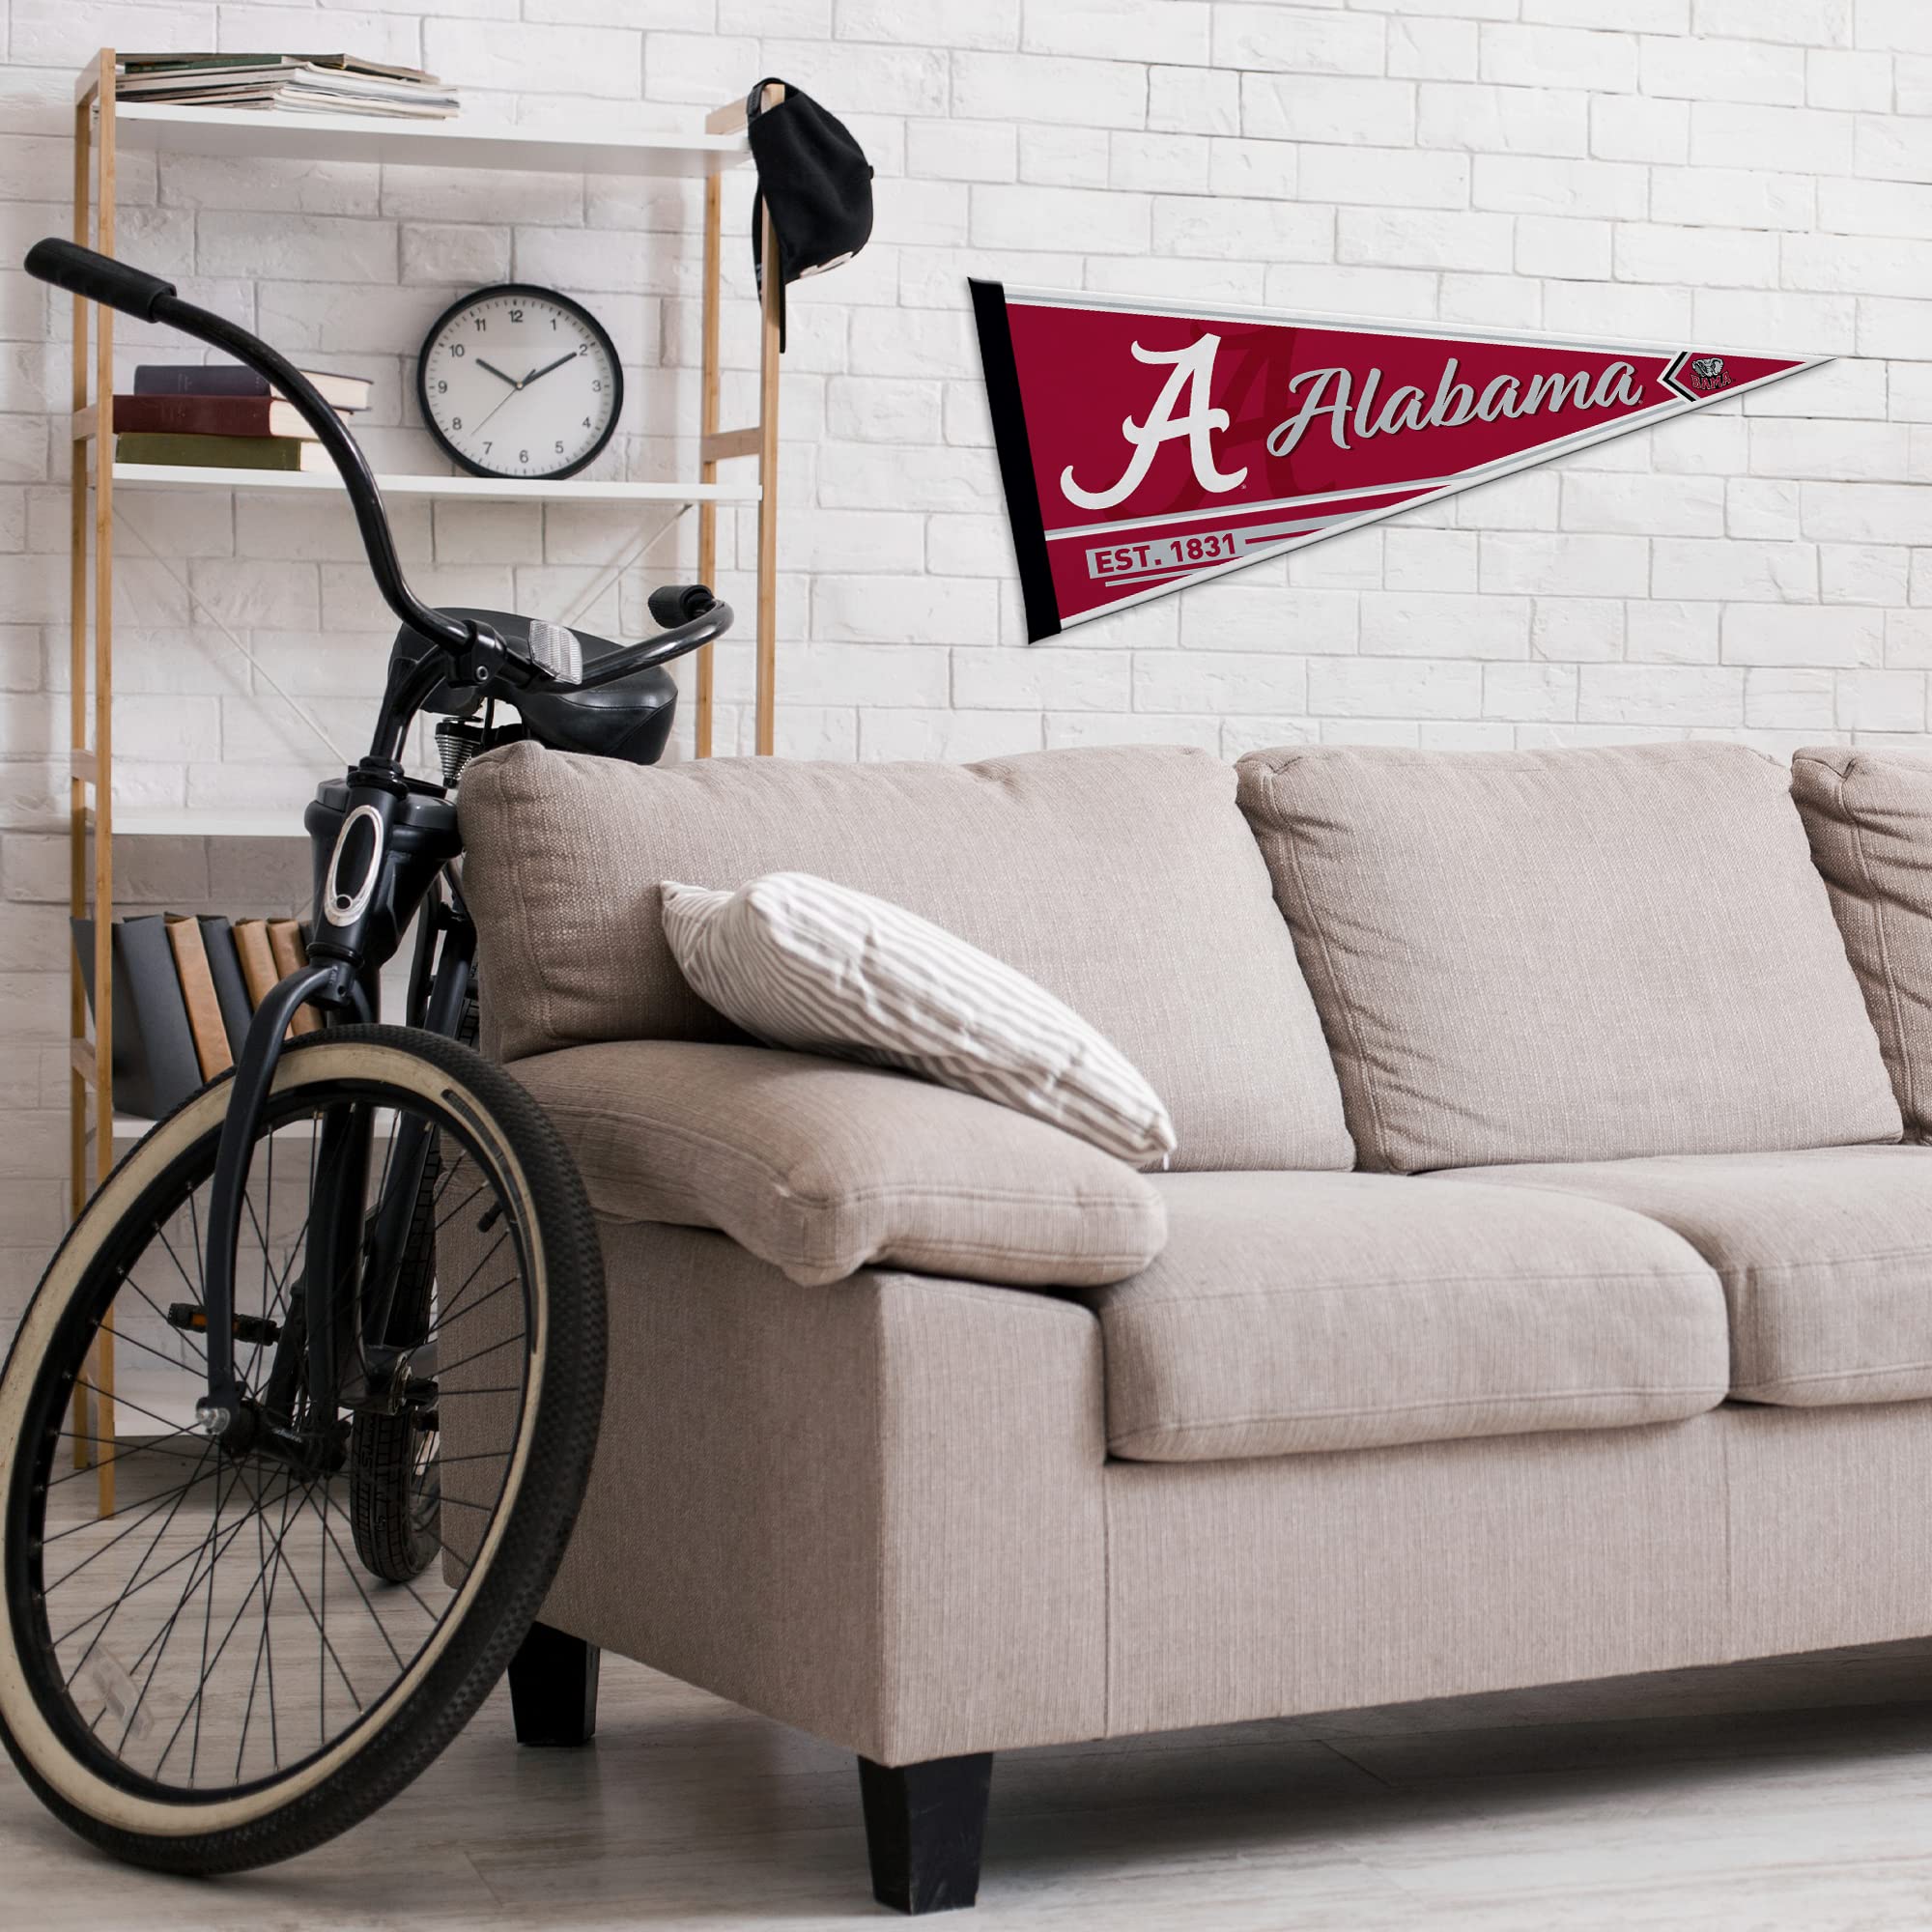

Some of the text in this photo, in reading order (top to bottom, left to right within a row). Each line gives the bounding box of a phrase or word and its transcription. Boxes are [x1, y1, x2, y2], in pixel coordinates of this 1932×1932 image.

[508, 310, 524, 323] 12
[475, 319, 487, 331] 11
[550, 319, 557, 331] 1
[449, 344, 466, 357] 10
[580, 344, 588, 355] 2
[592, 380, 602, 392] 3
[1690, 371, 1732, 390] BAMA
[438, 381, 448, 394] 9
[1266, 357, 1643, 458] Alabama
[452, 417, 462, 431] 8
[582, 417, 591, 428] 4
[1061, 332, 1248, 510] A
[483, 441, 493, 455] 7
[554, 441, 564, 454] 5
[519, 450, 529, 464] 6
[1094, 532, 1236, 575] EST. 1831
